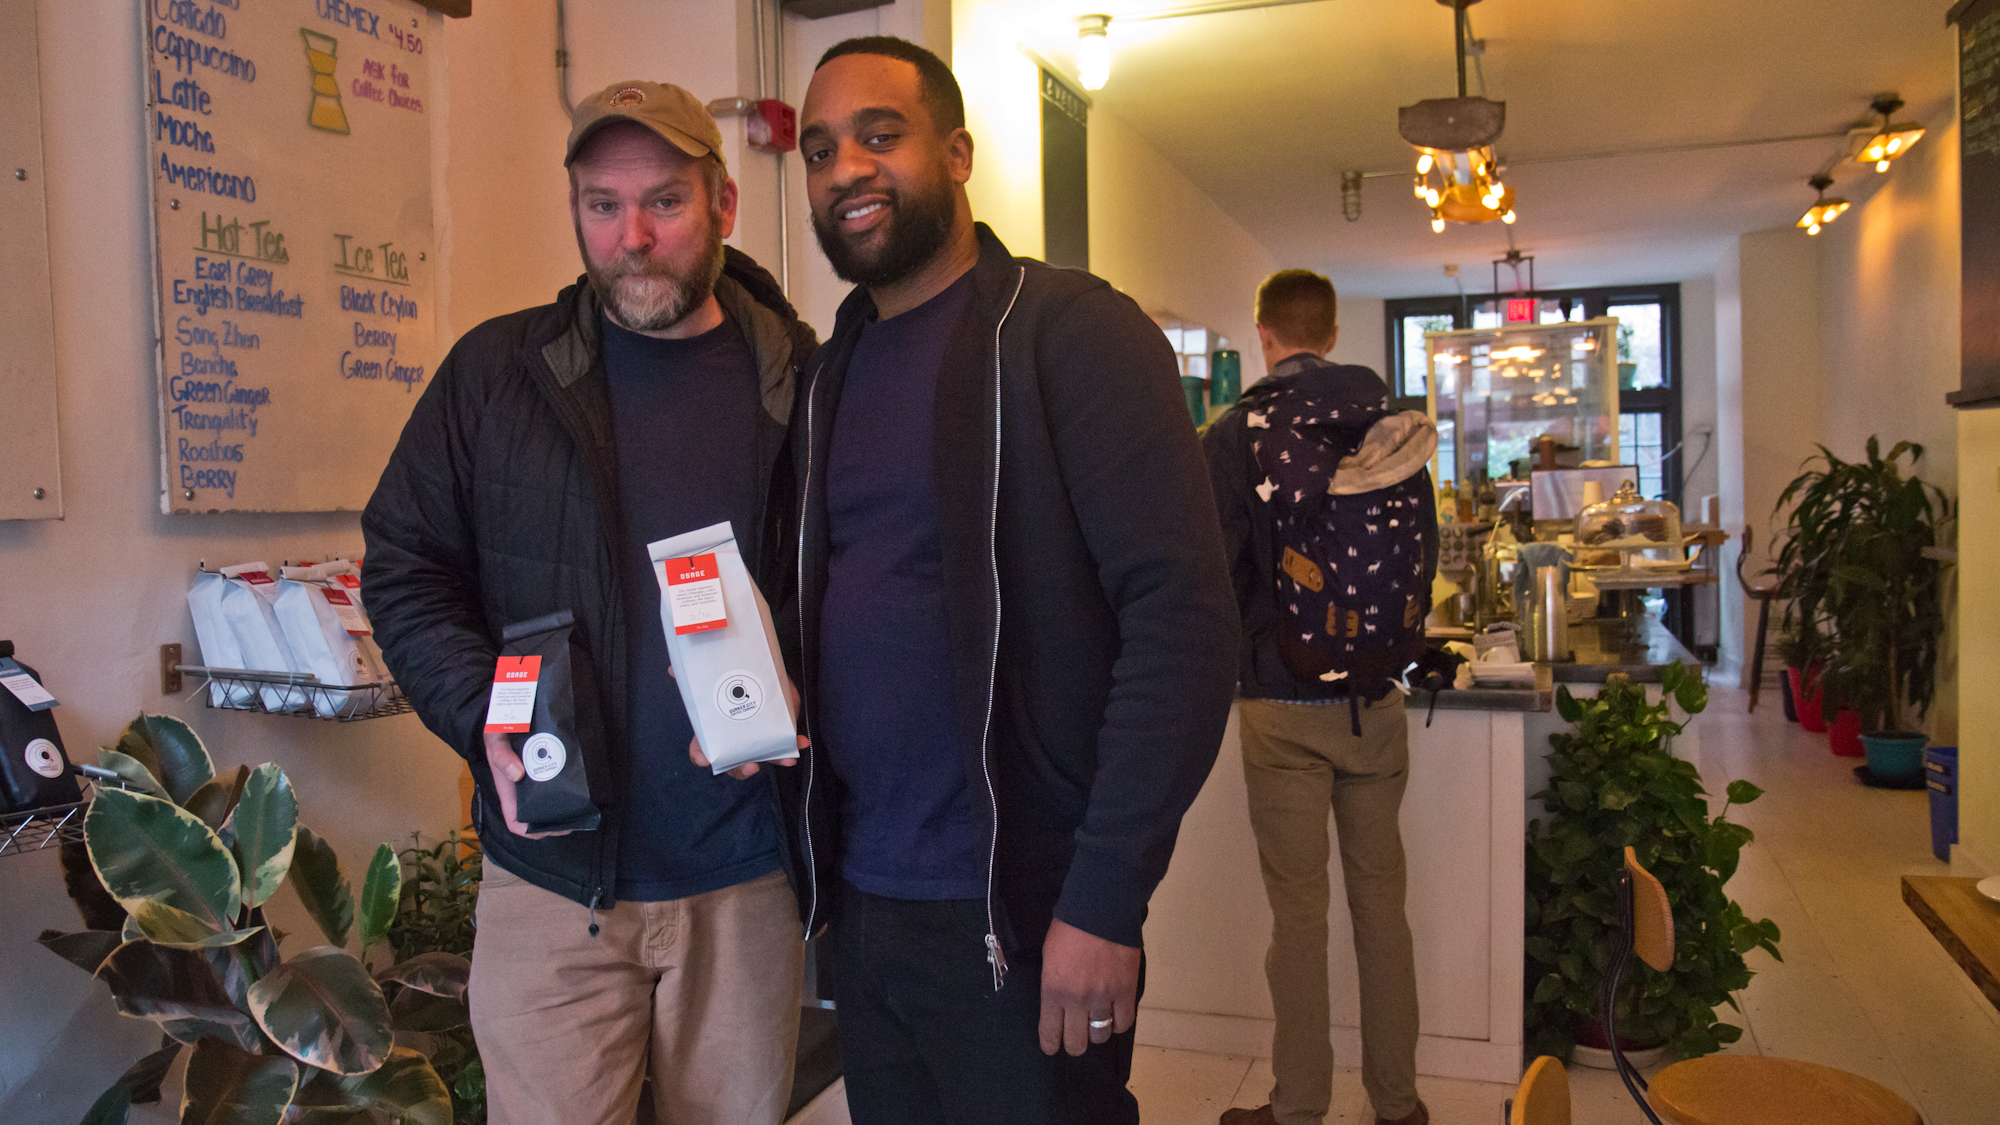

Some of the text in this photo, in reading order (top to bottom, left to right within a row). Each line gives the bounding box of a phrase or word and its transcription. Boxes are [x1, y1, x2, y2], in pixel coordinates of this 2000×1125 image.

[316, 0, 380, 40] CHEMEX
[155, 24, 256, 82] Cappuccino
[156, 69, 212, 116] Latte
[157, 111, 215, 153] Mocha
[201, 211, 290, 263] Hot Tea
[334, 233, 409, 281] Ice Tea
[173, 279, 305, 318] English Breakfast
[340, 285, 418, 323] Black Ceylon
[178, 437, 244, 462] Rooibos
